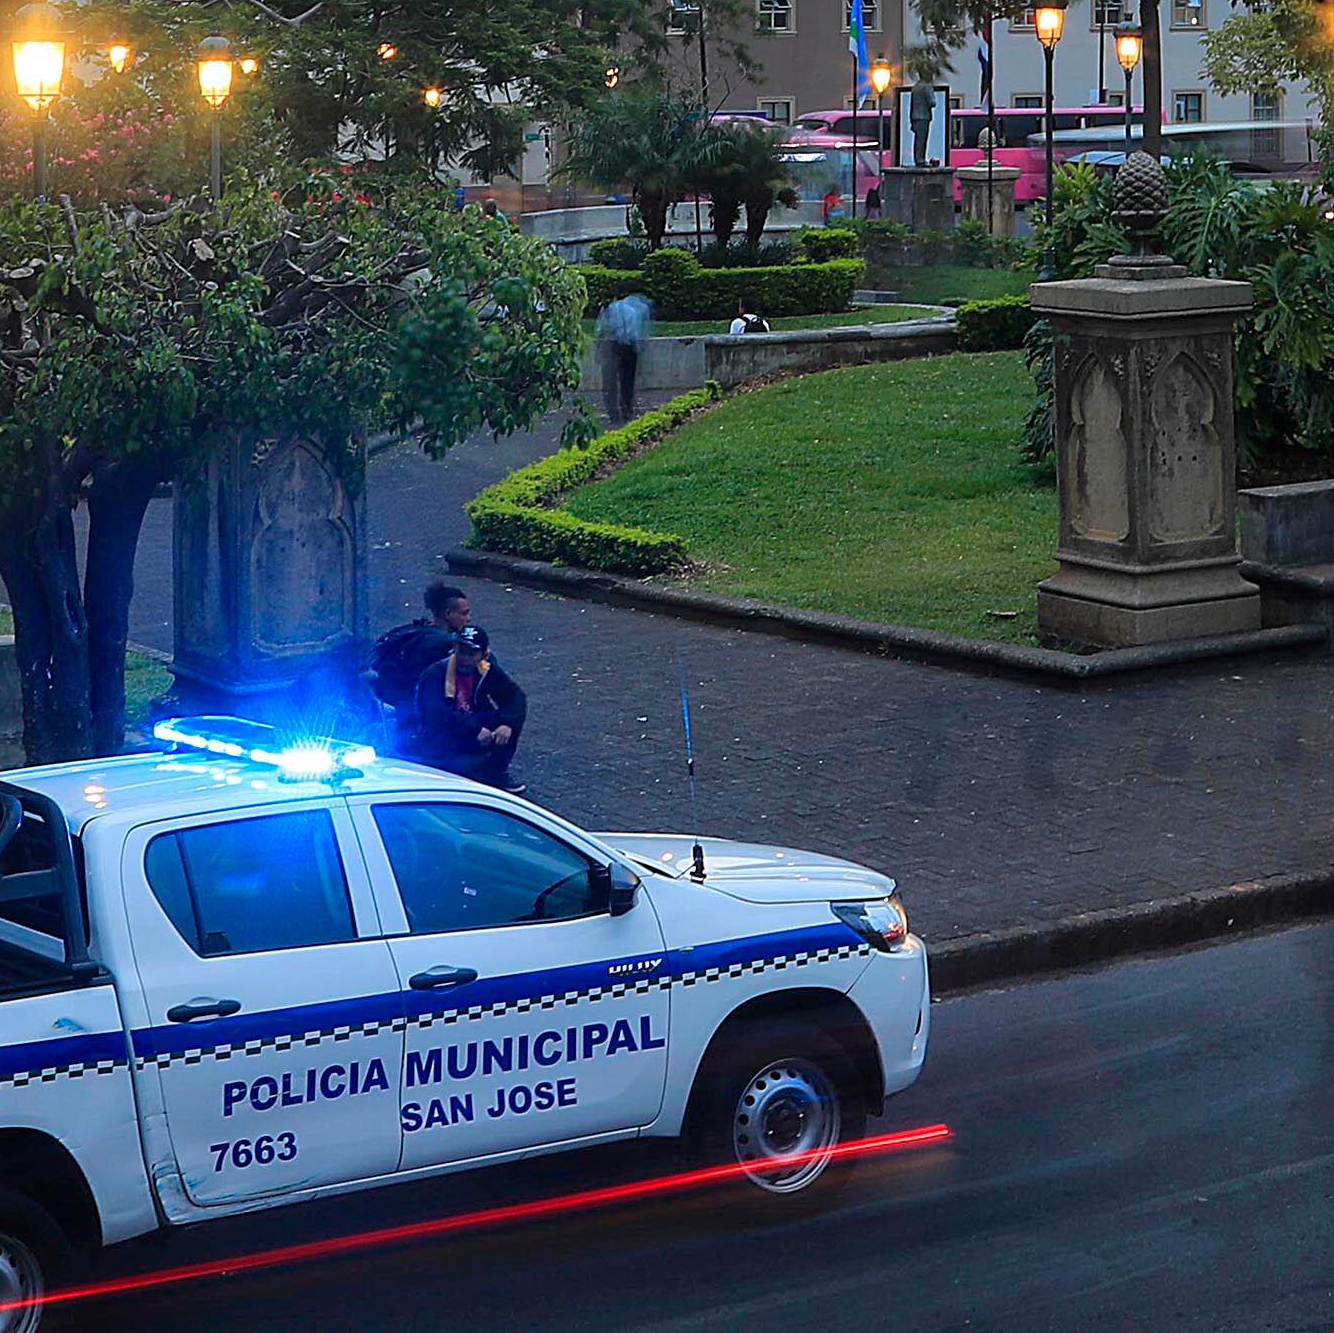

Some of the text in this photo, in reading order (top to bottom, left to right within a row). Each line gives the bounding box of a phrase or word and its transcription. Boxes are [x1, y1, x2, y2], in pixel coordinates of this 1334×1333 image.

[223, 1016, 666, 1116] POLICIA MUNICIPAL
[402, 1078, 579, 1133] SAN JOSE
[210, 1132, 298, 1173] 7663
